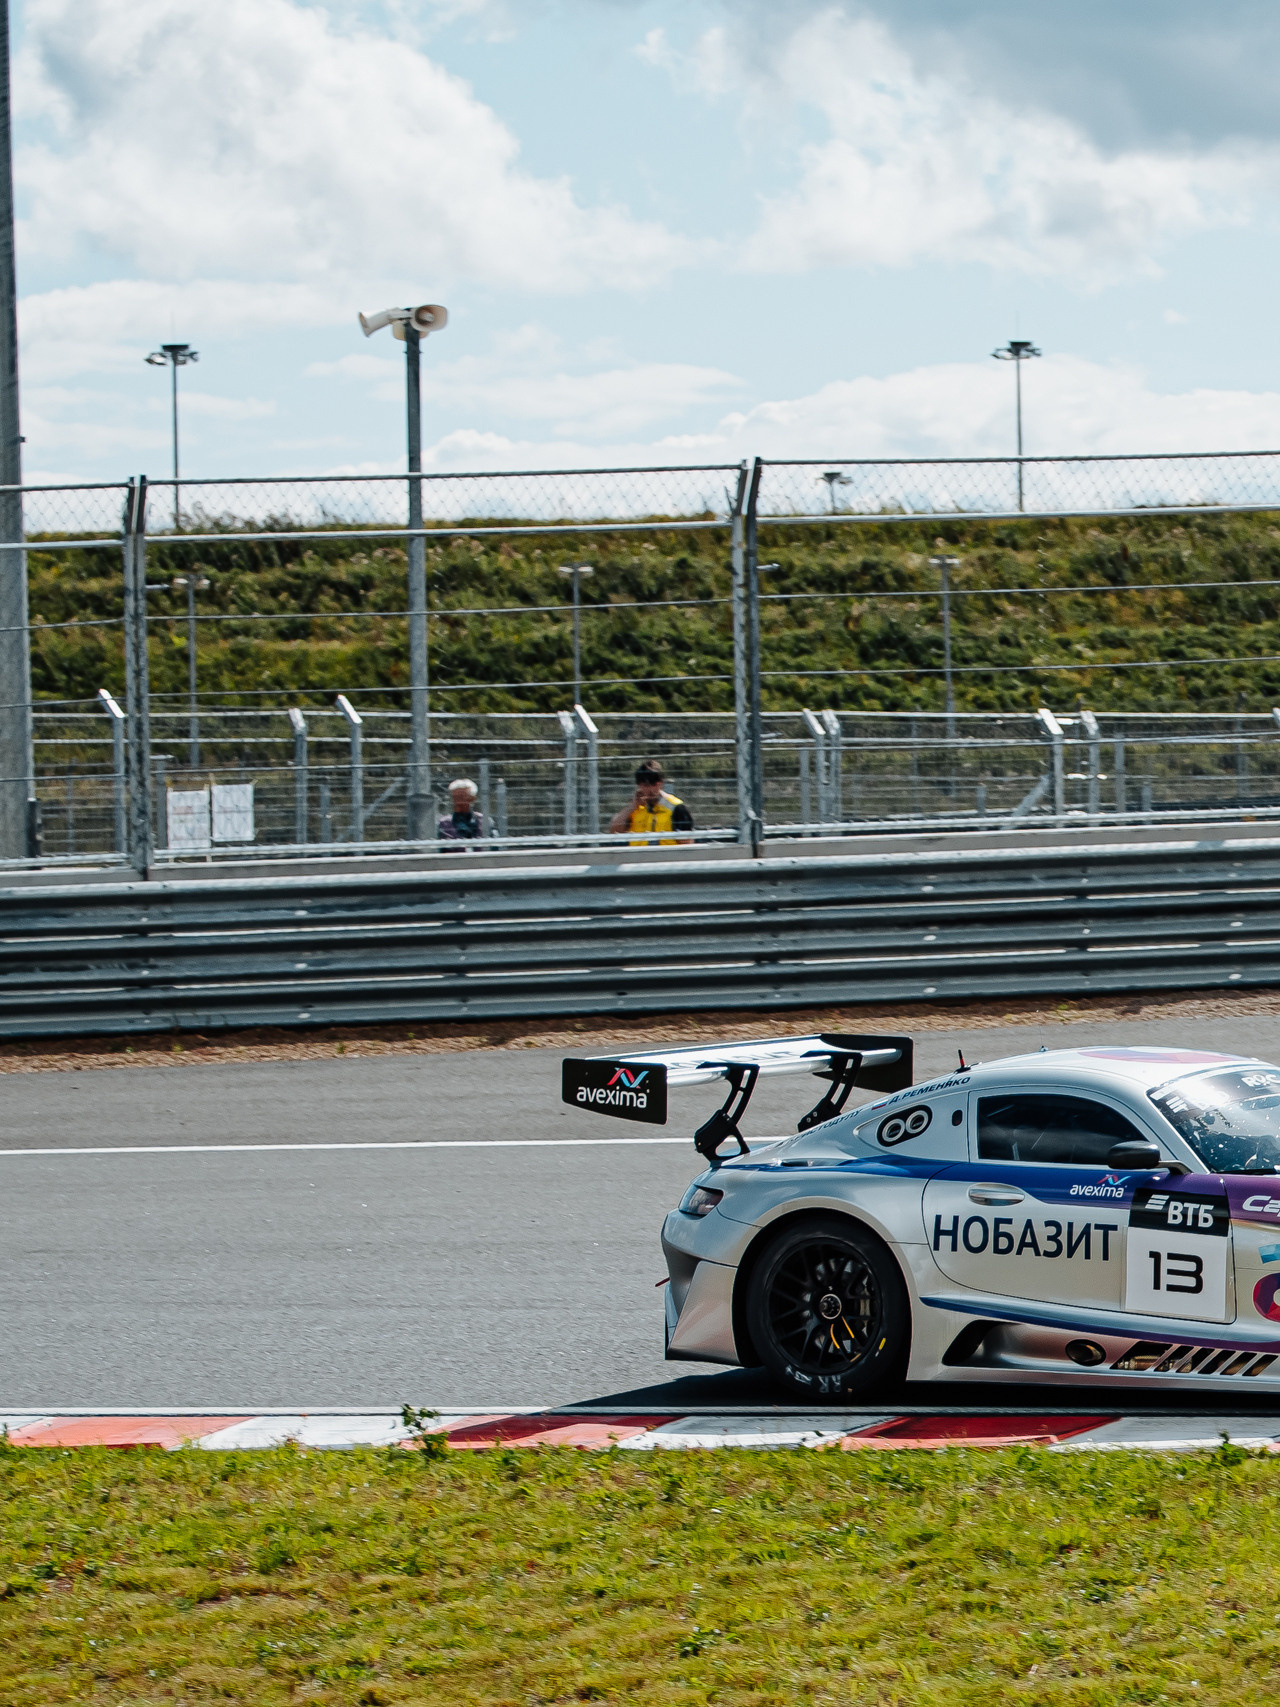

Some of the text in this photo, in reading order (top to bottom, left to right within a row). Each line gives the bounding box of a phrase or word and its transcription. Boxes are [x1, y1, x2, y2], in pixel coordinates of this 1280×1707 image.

[576, 1086, 648, 1109] avexima
[889, 1076, 971, 1105] Д.РЕМЕНЯКО
[1069, 1183, 1125, 1198] avexima
[1167, 1201, 1215, 1228] ВТБ
[932, 1214, 1119, 1261] НОБАЗИТ
[1148, 1250, 1204, 1294] 13
